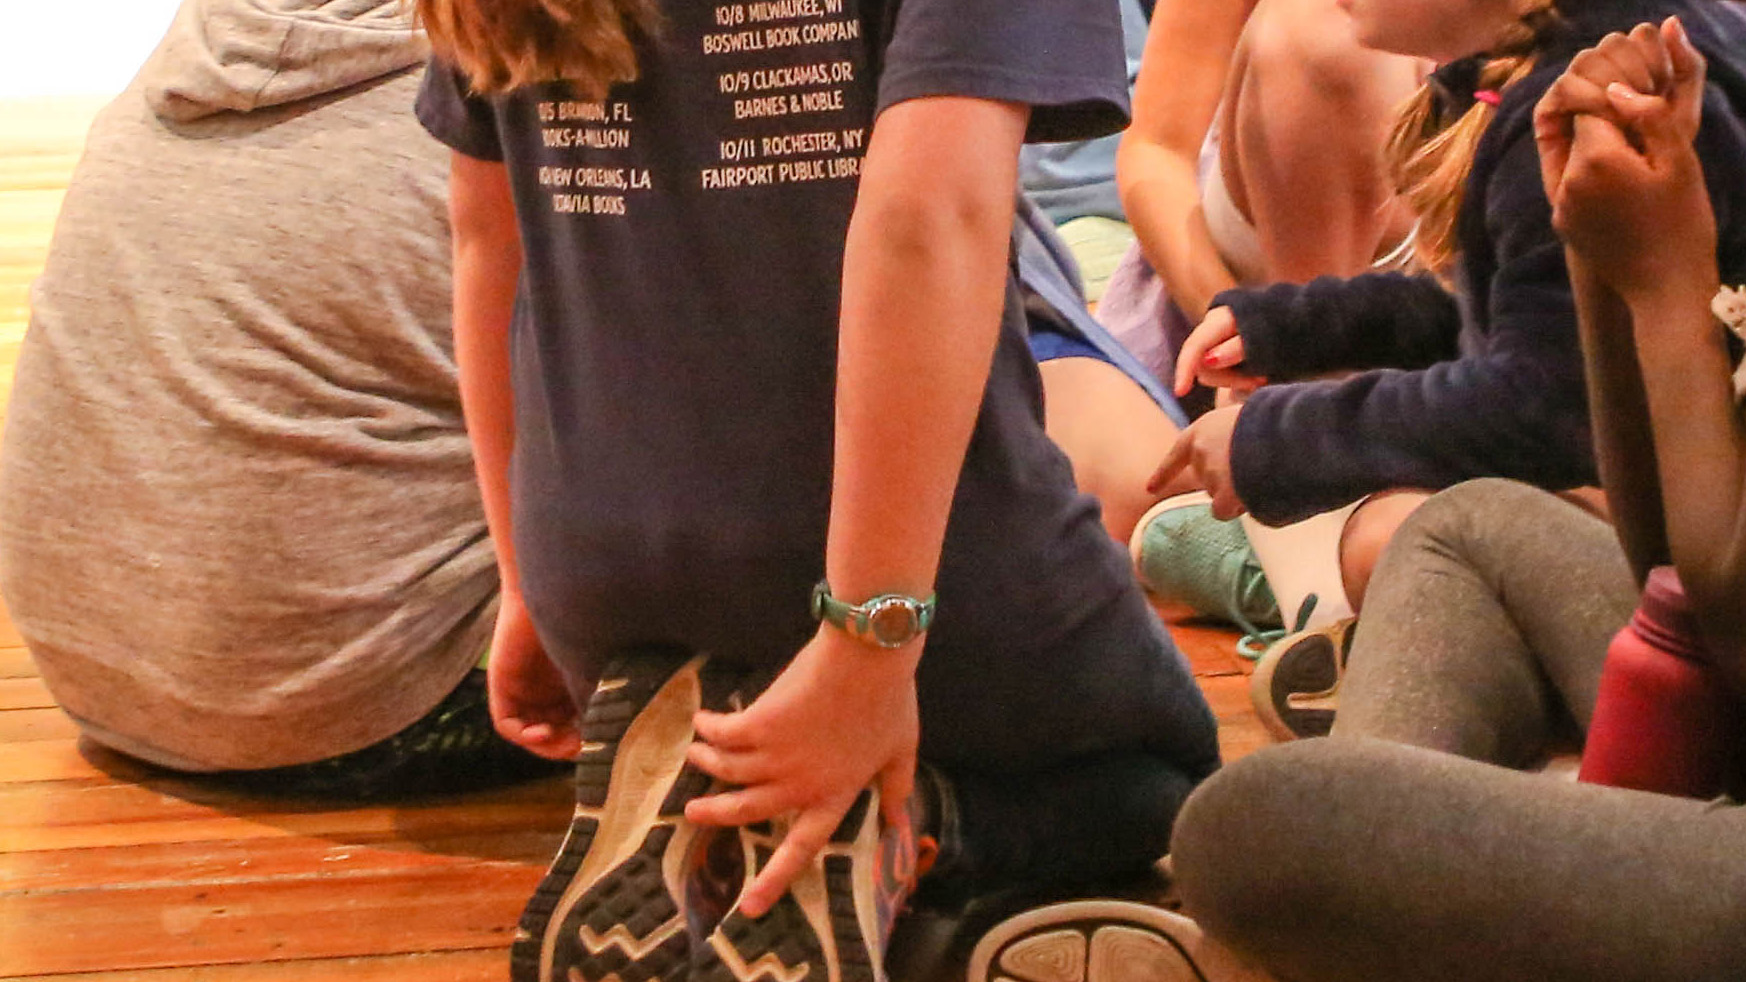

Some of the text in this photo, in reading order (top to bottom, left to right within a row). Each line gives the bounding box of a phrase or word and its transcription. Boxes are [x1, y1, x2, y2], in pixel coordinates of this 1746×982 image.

[716, 4, 744, 26] 10/8
[703, 19, 860, 55] BOSWELL BOOK COMPAN
[719, 71, 749, 93] 10/9
[613, 102, 633, 122] FL
[734, 90, 844, 119] BARNES & NOBLE
[720, 128, 864, 161] 10/11 ROCHESTER, NY
[630, 168, 652, 189] LA
[702, 156, 862, 189] FAIRPORT PUBLIC LIBR
